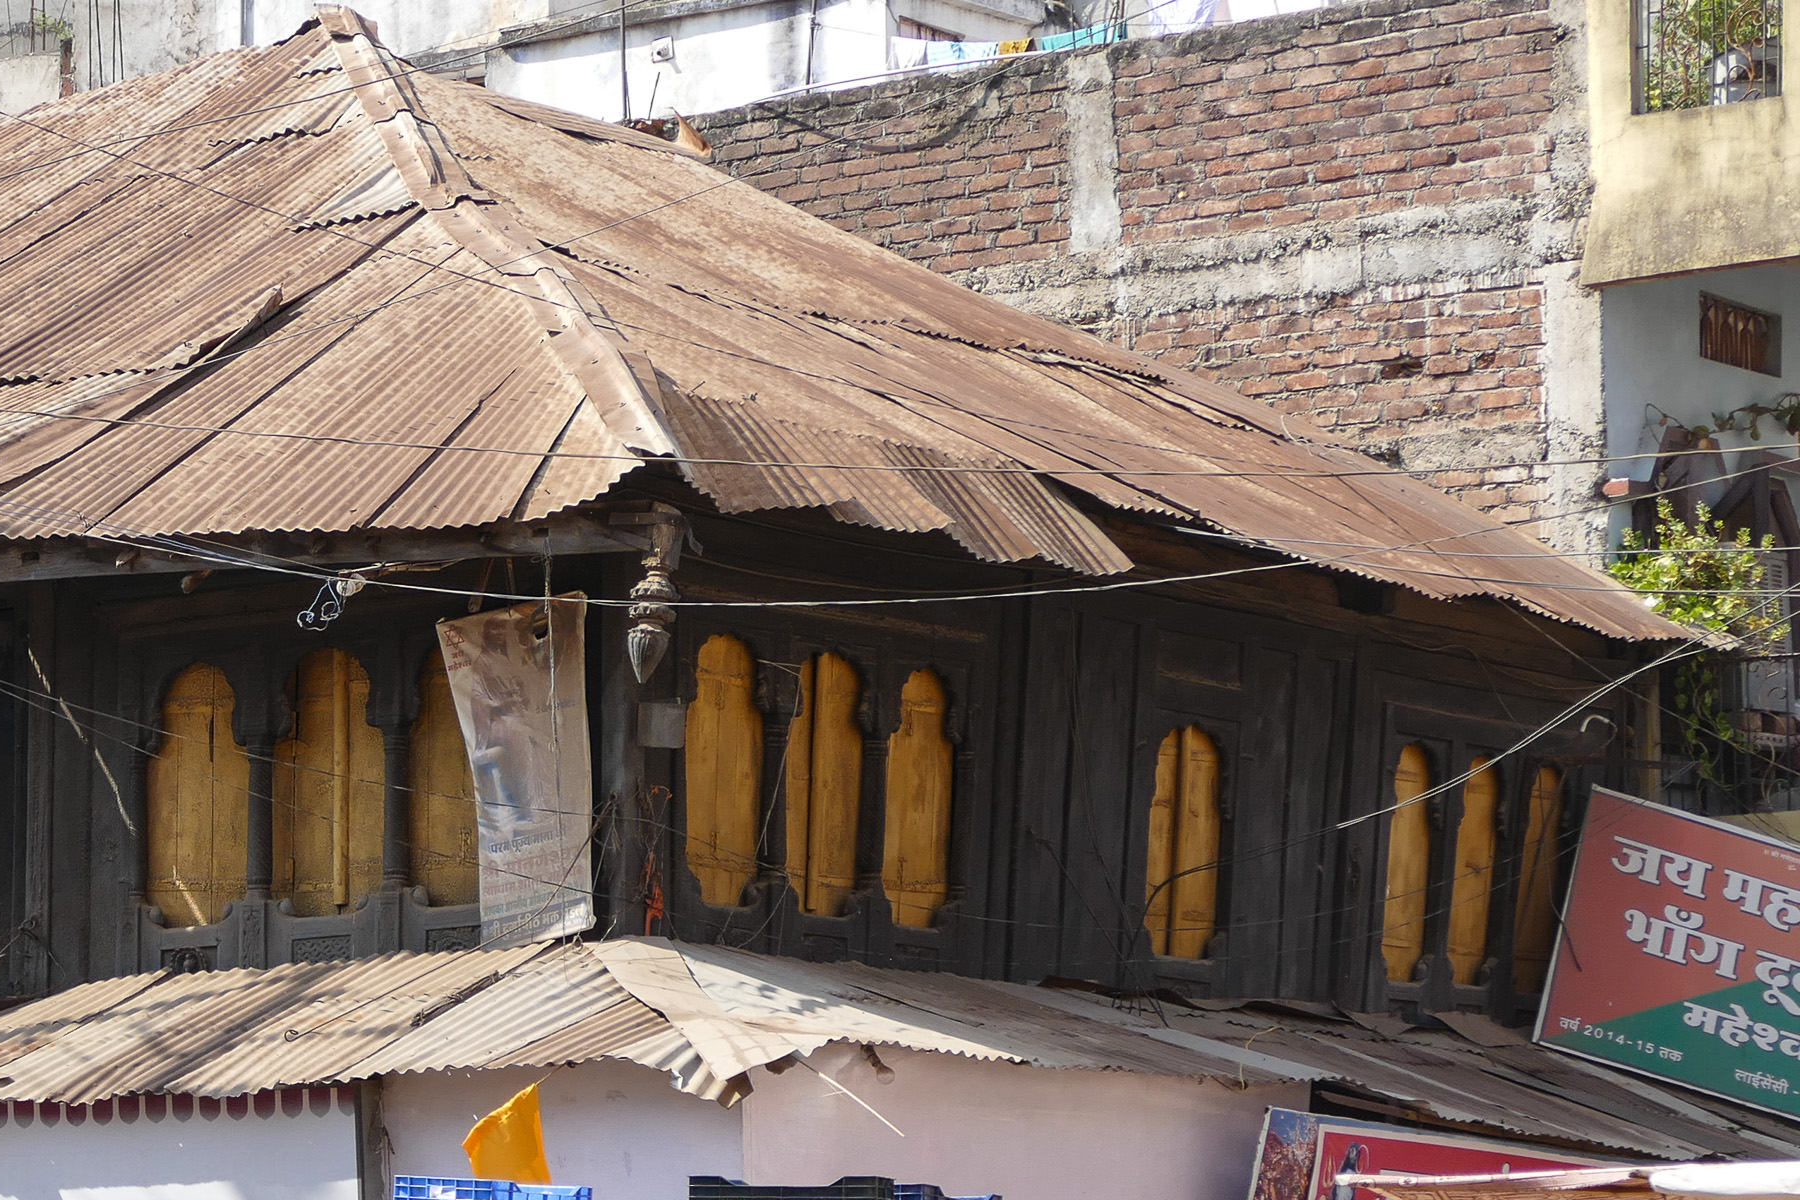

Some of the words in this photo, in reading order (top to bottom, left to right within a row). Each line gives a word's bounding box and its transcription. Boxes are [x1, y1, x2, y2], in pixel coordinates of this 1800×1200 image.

[1611, 835, 1714, 900] जय
[1558, 1016, 1582, 1032] वर्ष
[1583, 1023, 1655, 1055] 2014-15
[1657, 1046, 1684, 1063] तक
